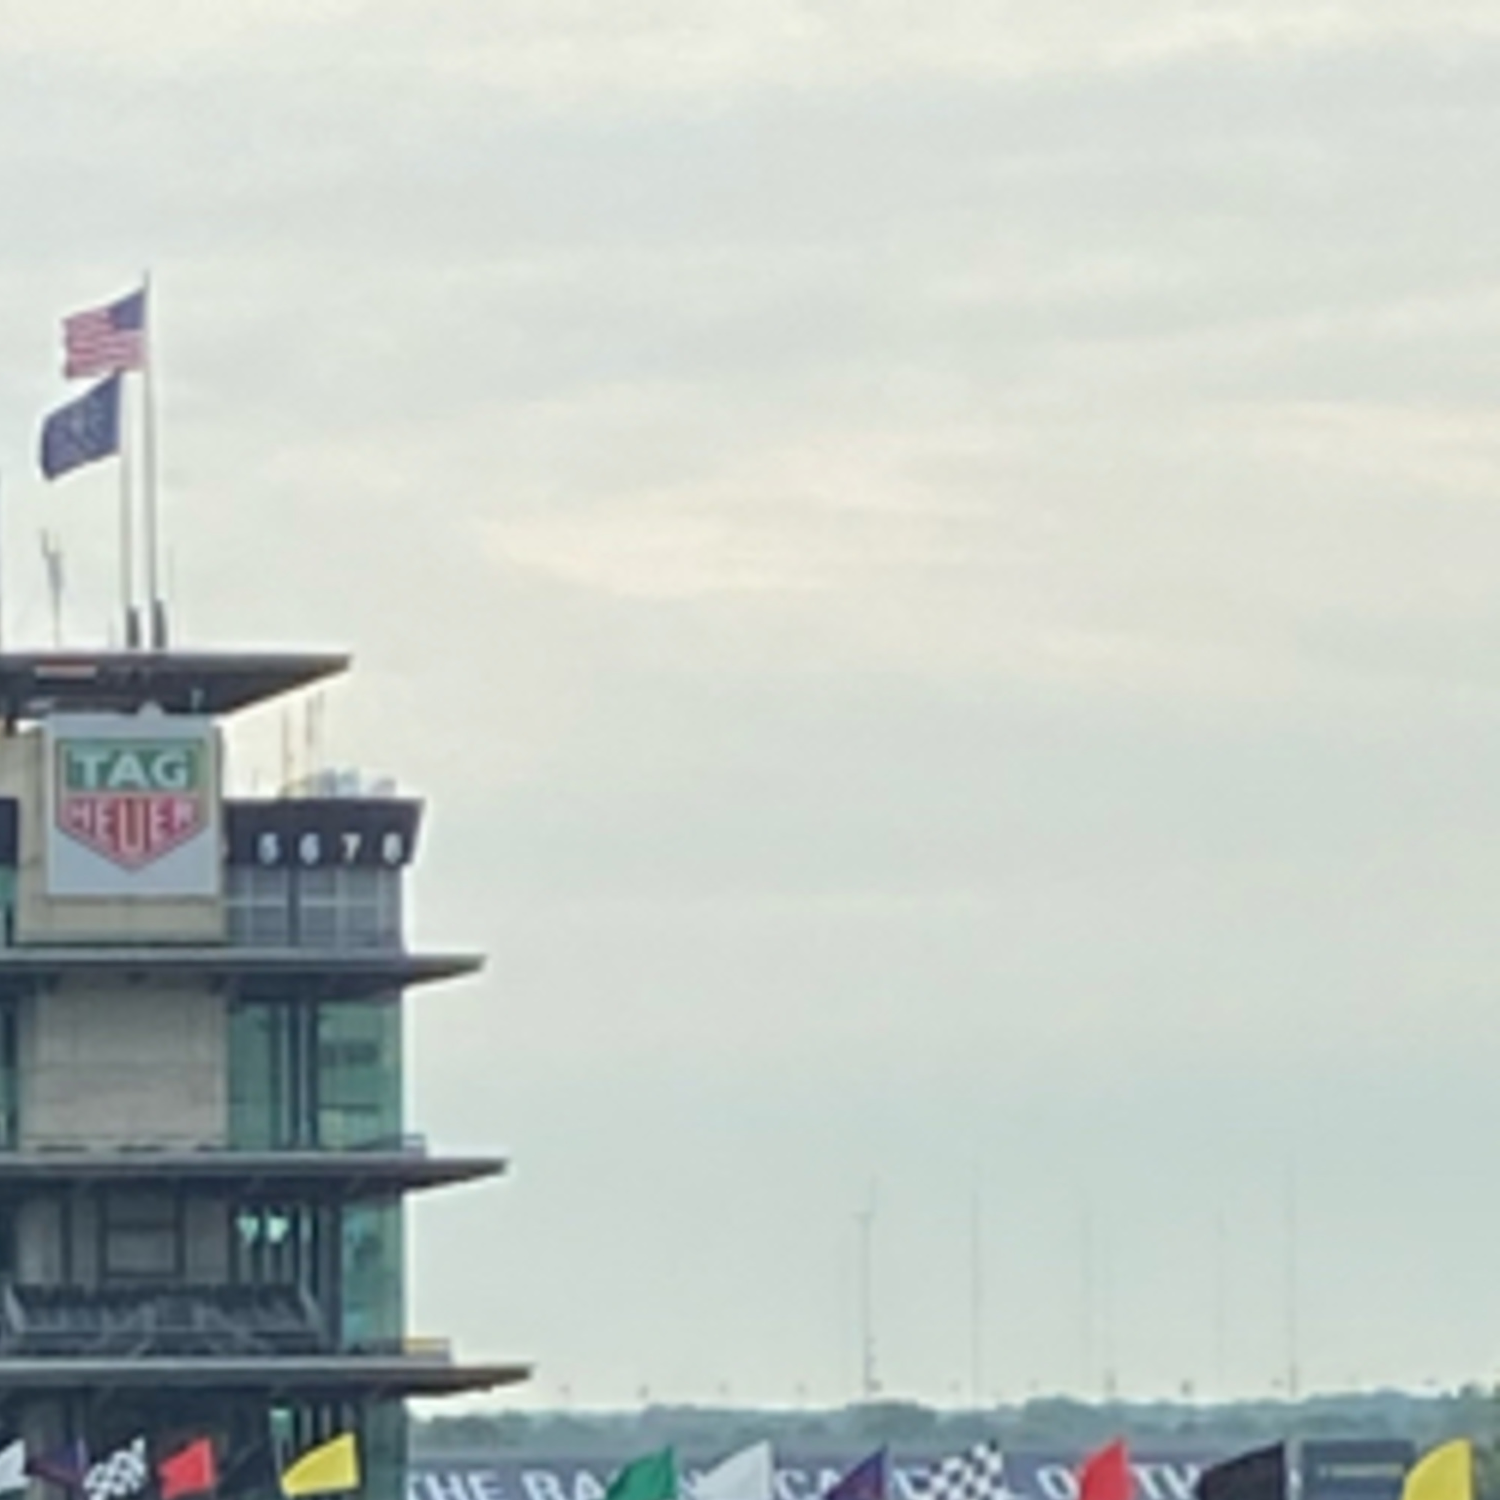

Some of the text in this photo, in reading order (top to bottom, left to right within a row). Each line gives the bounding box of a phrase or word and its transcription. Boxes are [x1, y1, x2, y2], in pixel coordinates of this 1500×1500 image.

[71, 750, 188, 789] TAG
[60, 798, 198, 861] HEUER
[339, 832, 363, 864] 7
